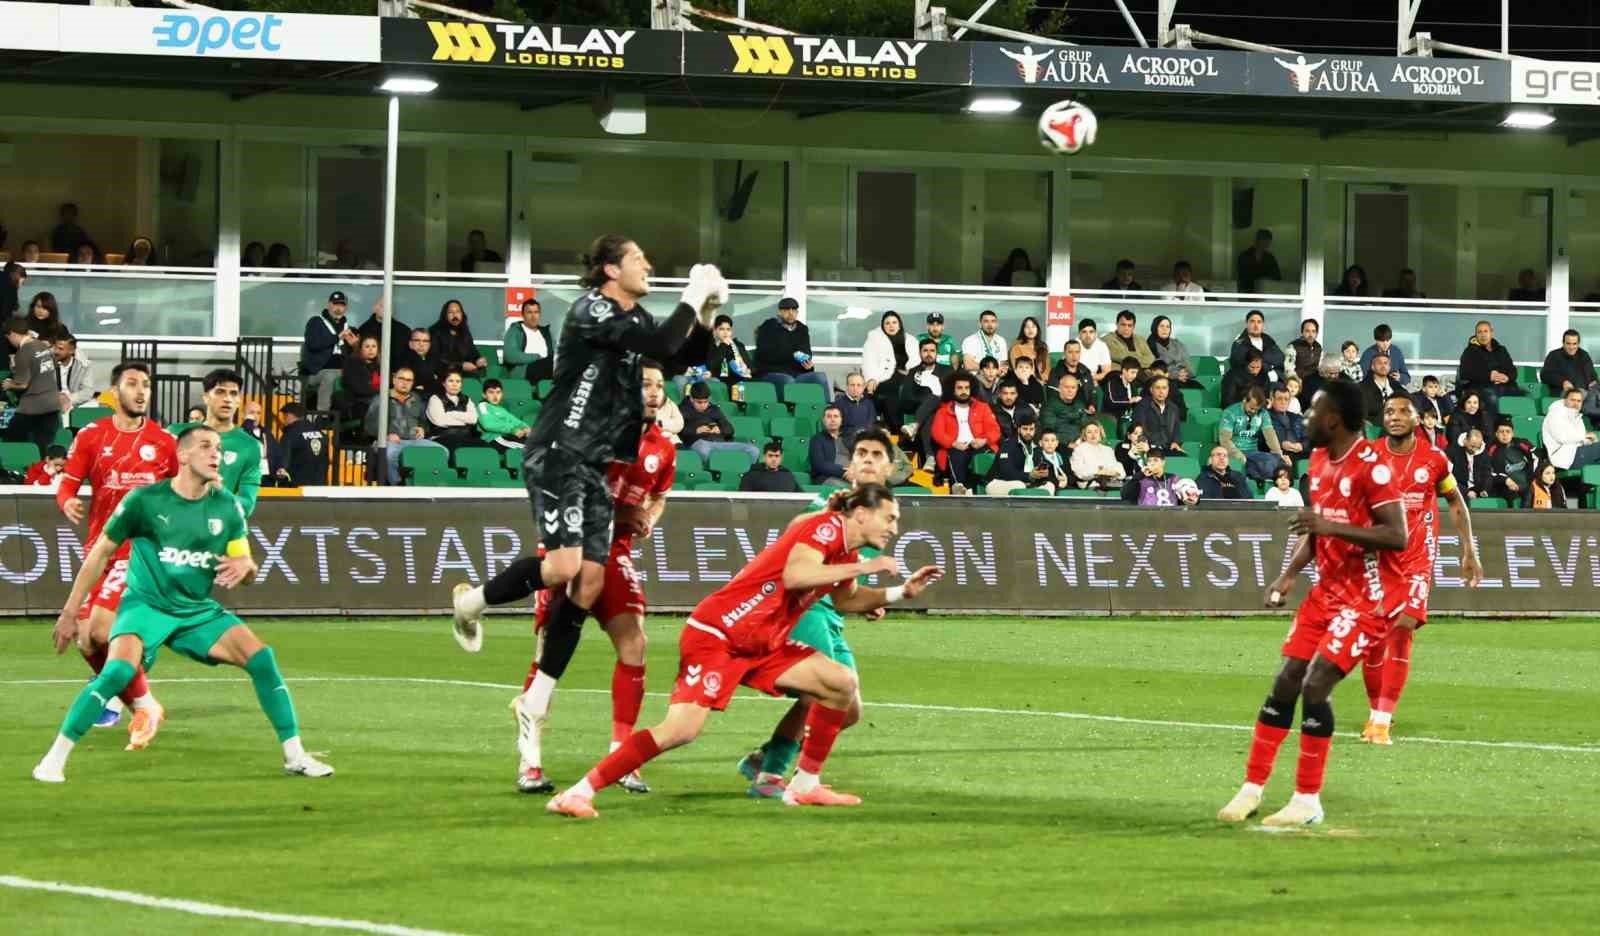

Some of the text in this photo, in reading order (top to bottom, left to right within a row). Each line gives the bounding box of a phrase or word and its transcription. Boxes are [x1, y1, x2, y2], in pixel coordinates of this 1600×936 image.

[152, 14, 282, 54] opet
[496, 24, 636, 55] TALAY
[505, 53, 625, 68] LOGISTICS
[793, 37, 927, 68] TALAY
[1058, 49, 1093, 62] GRUP
[802, 65, 917, 80] LOGISTICS
[1043, 61, 1111, 84] AURA
[1120, 53, 1219, 77] ACROPOL
[1330, 59, 1363, 72] GRUP
[1390, 63, 1485, 86] ACROPOL
[1144, 73, 1195, 87] BODRUM
[1315, 71, 1380, 93] AURA
[1412, 83, 1462, 96] BODRUM
[1525, 70, 1600, 99] gre
[158, 546, 215, 569] opet
